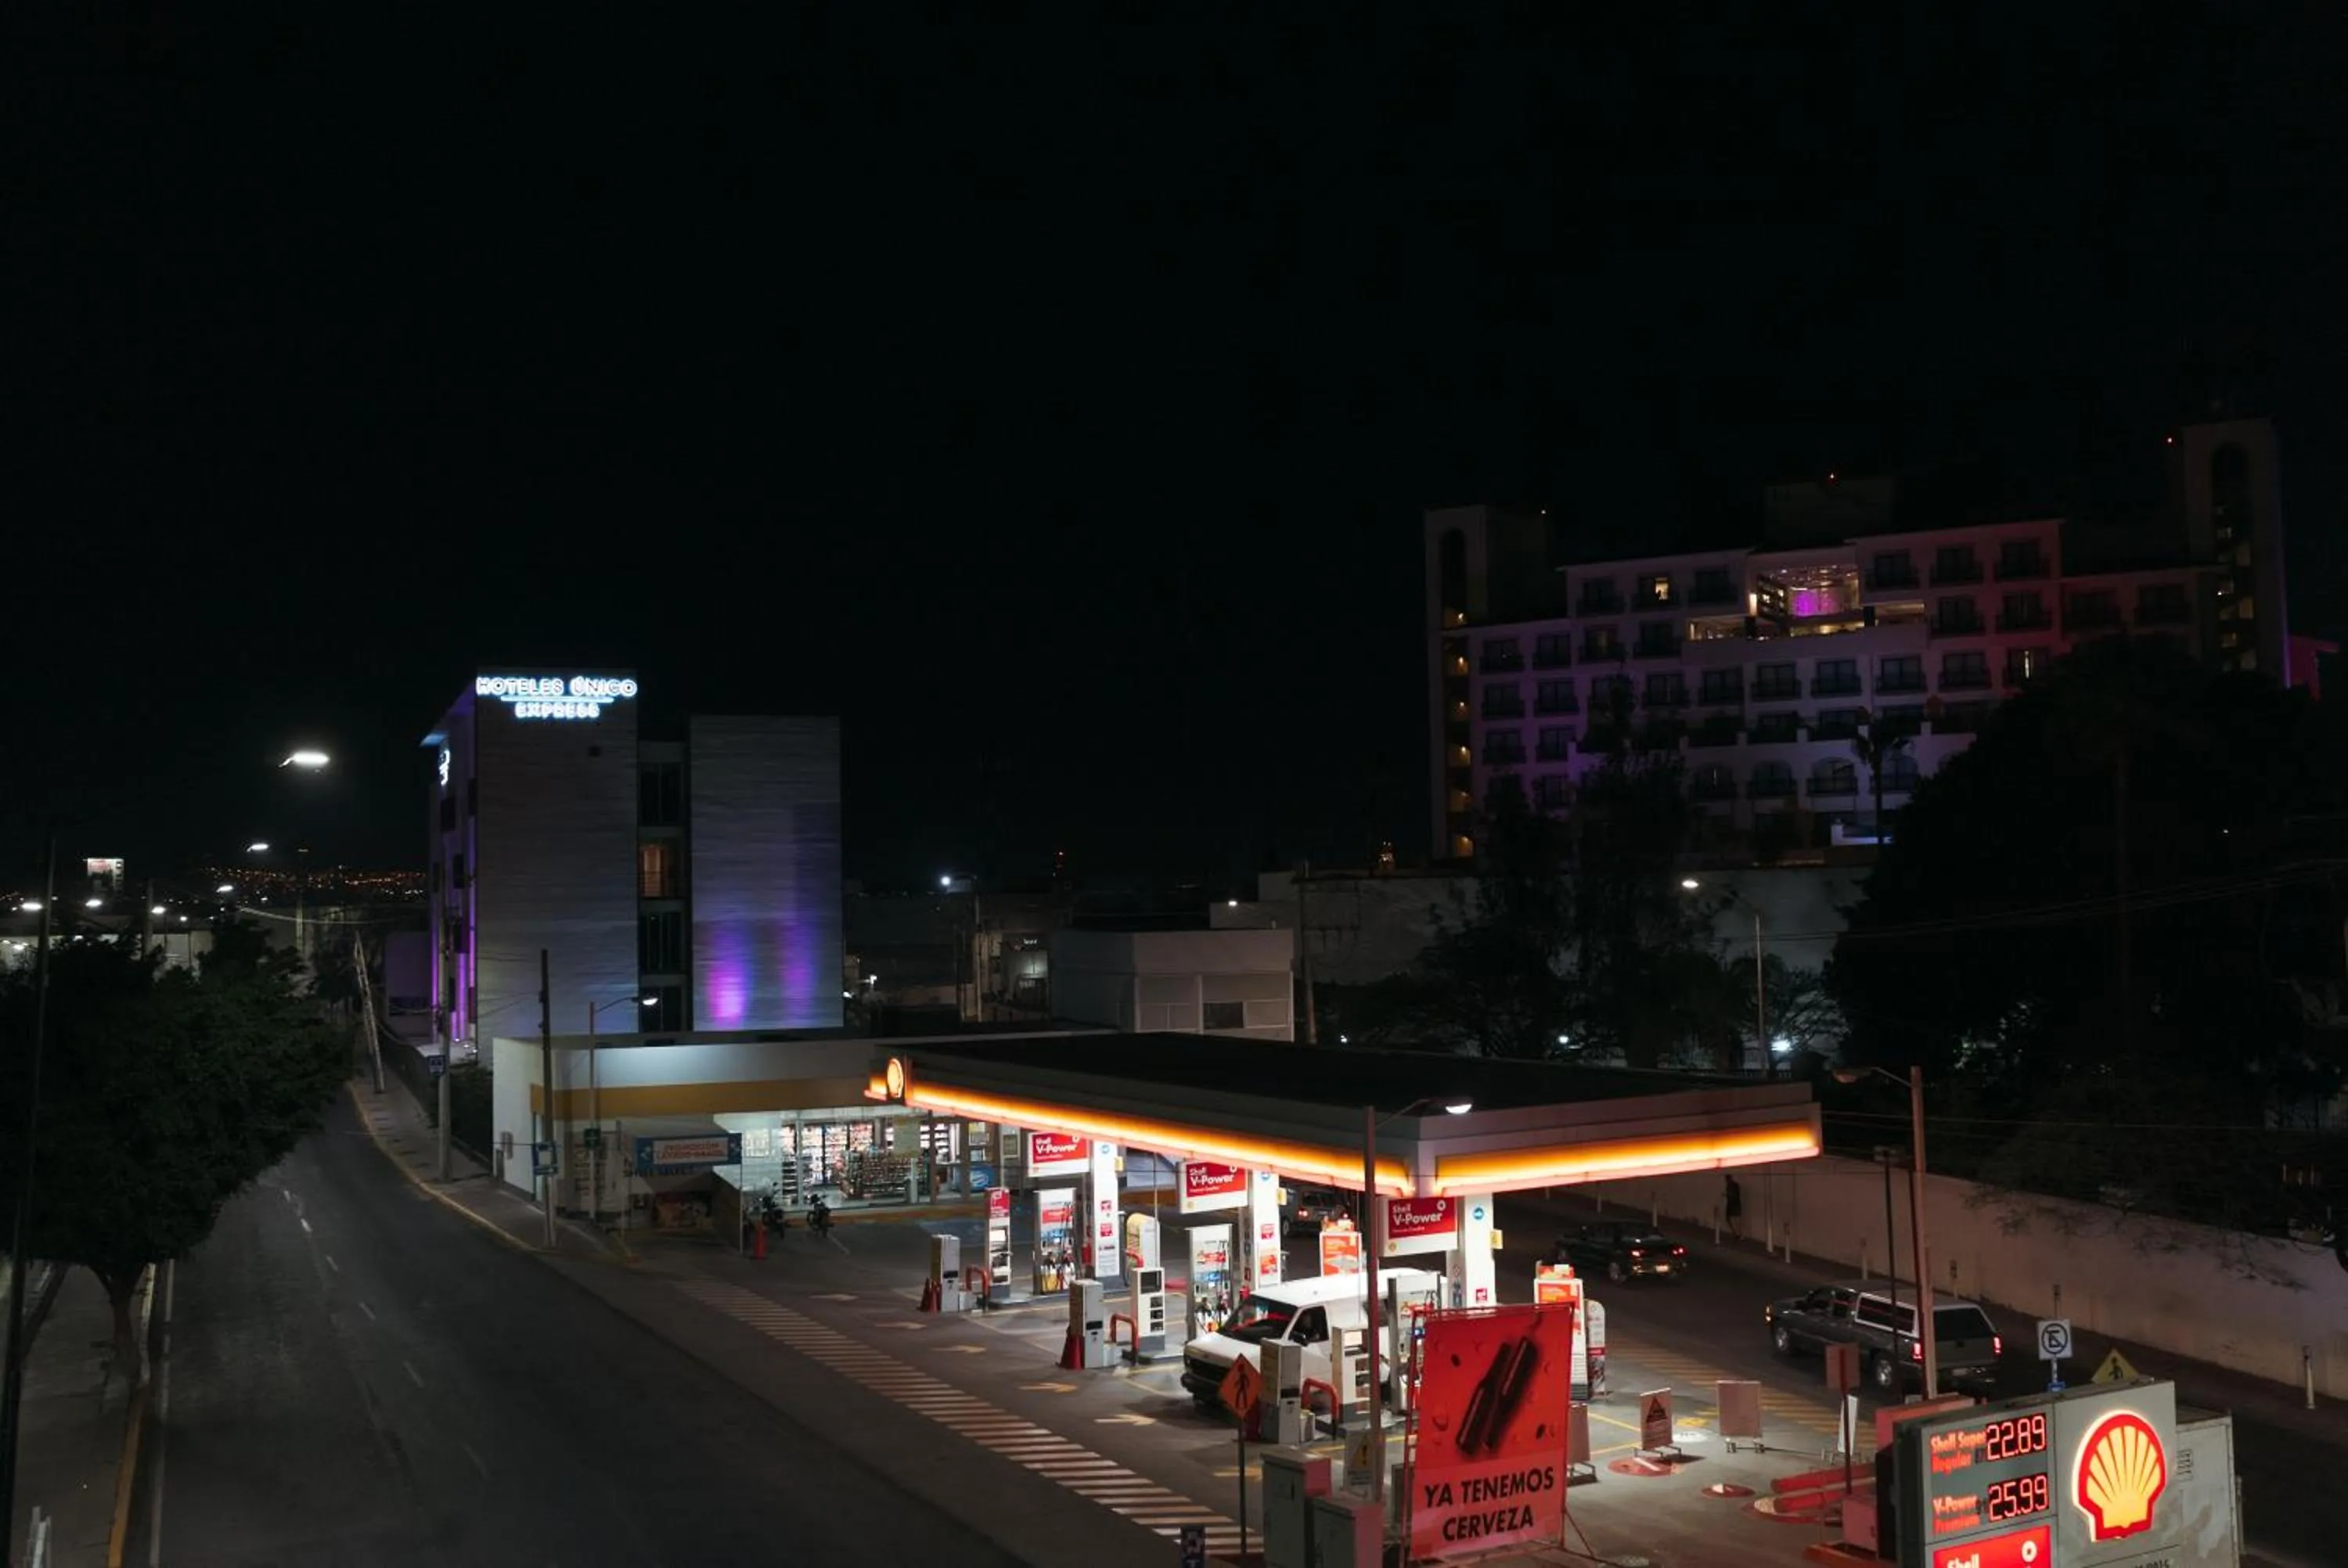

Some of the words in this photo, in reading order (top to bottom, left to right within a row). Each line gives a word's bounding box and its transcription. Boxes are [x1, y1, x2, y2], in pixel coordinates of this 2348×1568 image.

[476, 676, 564, 696] HOTELES
[1036, 1144, 1078, 1154] V-Power
[1190, 1175, 1234, 1186] V-Power
[1393, 1213, 1443, 1225] V-Power
[1986, 1415, 2045, 1460] 22.89
[1424, 1483, 1453, 1508] YA
[1461, 1467, 1554, 1503] TENEMOS
[1989, 1476, 2047, 1520] 25.99
[1442, 1505, 1534, 1541] CERVEZA
